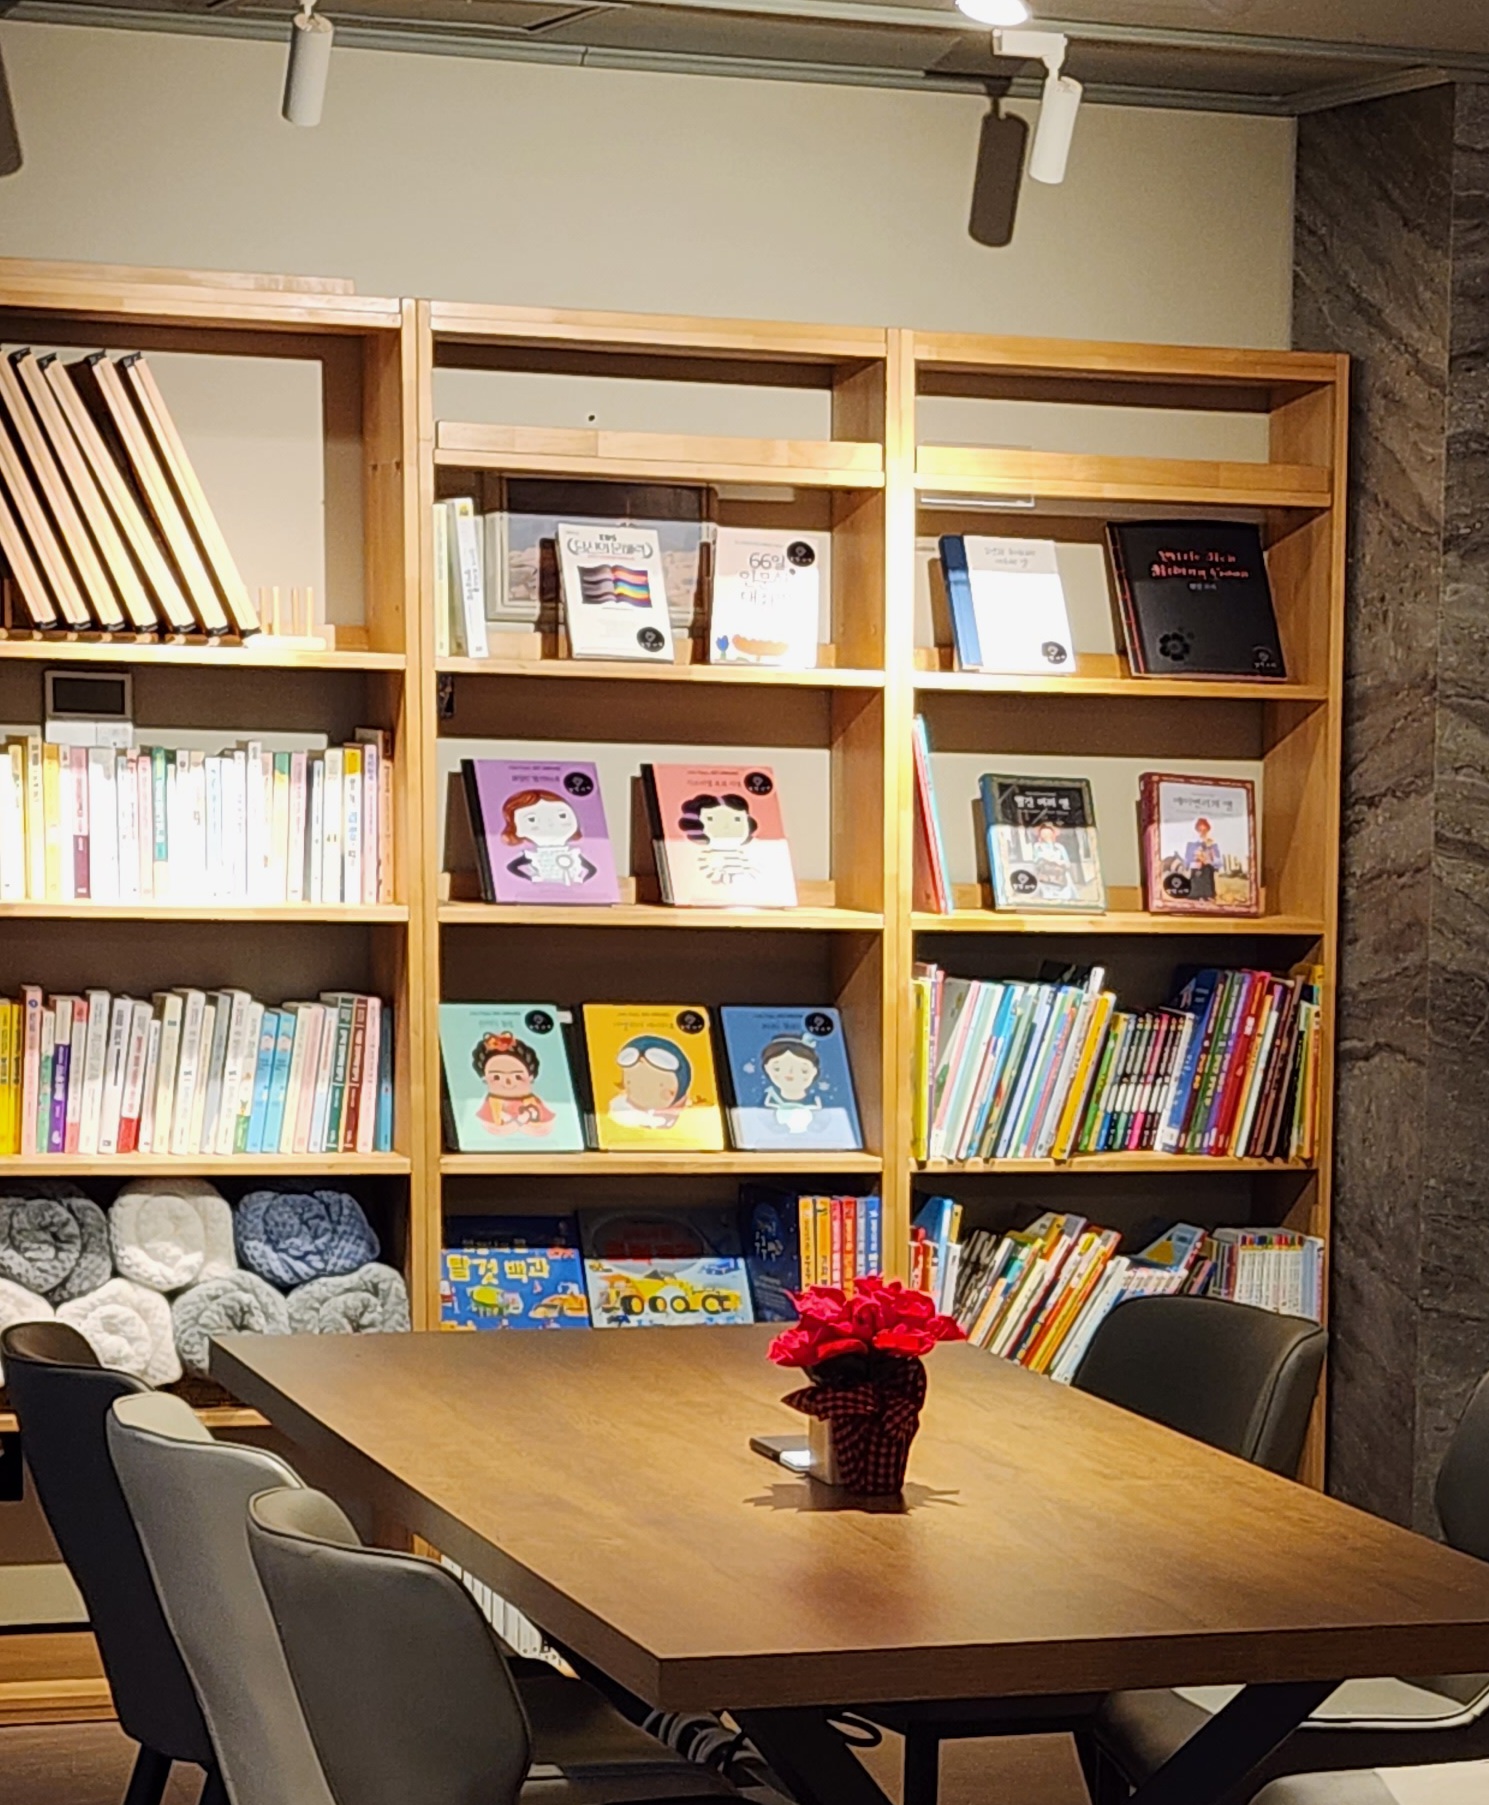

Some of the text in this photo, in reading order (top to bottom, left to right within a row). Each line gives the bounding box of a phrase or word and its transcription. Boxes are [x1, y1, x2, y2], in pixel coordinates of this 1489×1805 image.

[749, 552, 785, 570] 66일
[446, 1254, 550, 1285] 탈것 백과
